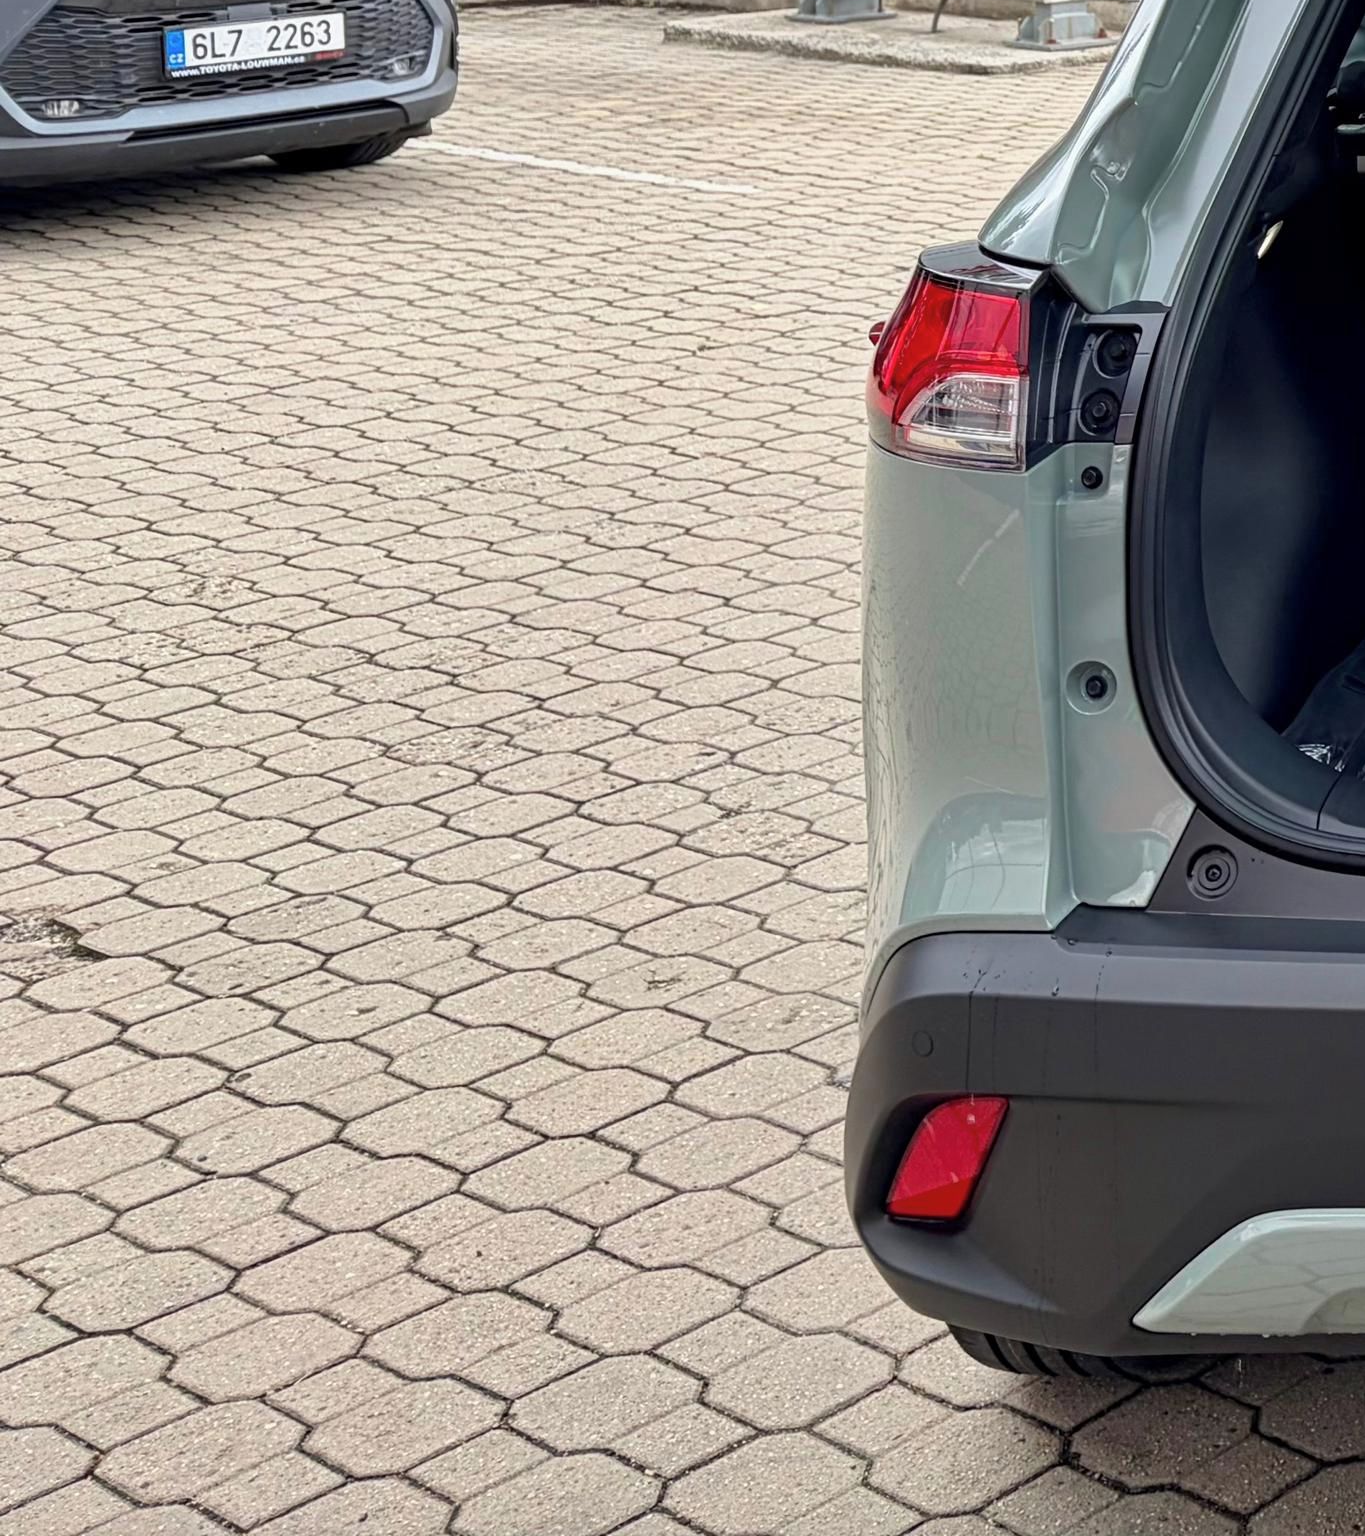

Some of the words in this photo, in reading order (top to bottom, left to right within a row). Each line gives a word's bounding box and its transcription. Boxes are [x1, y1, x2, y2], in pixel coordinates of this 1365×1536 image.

[191, 28, 244, 61] 6L7
[265, 19, 332, 52] 2263
[169, 53, 184, 64] CZ
